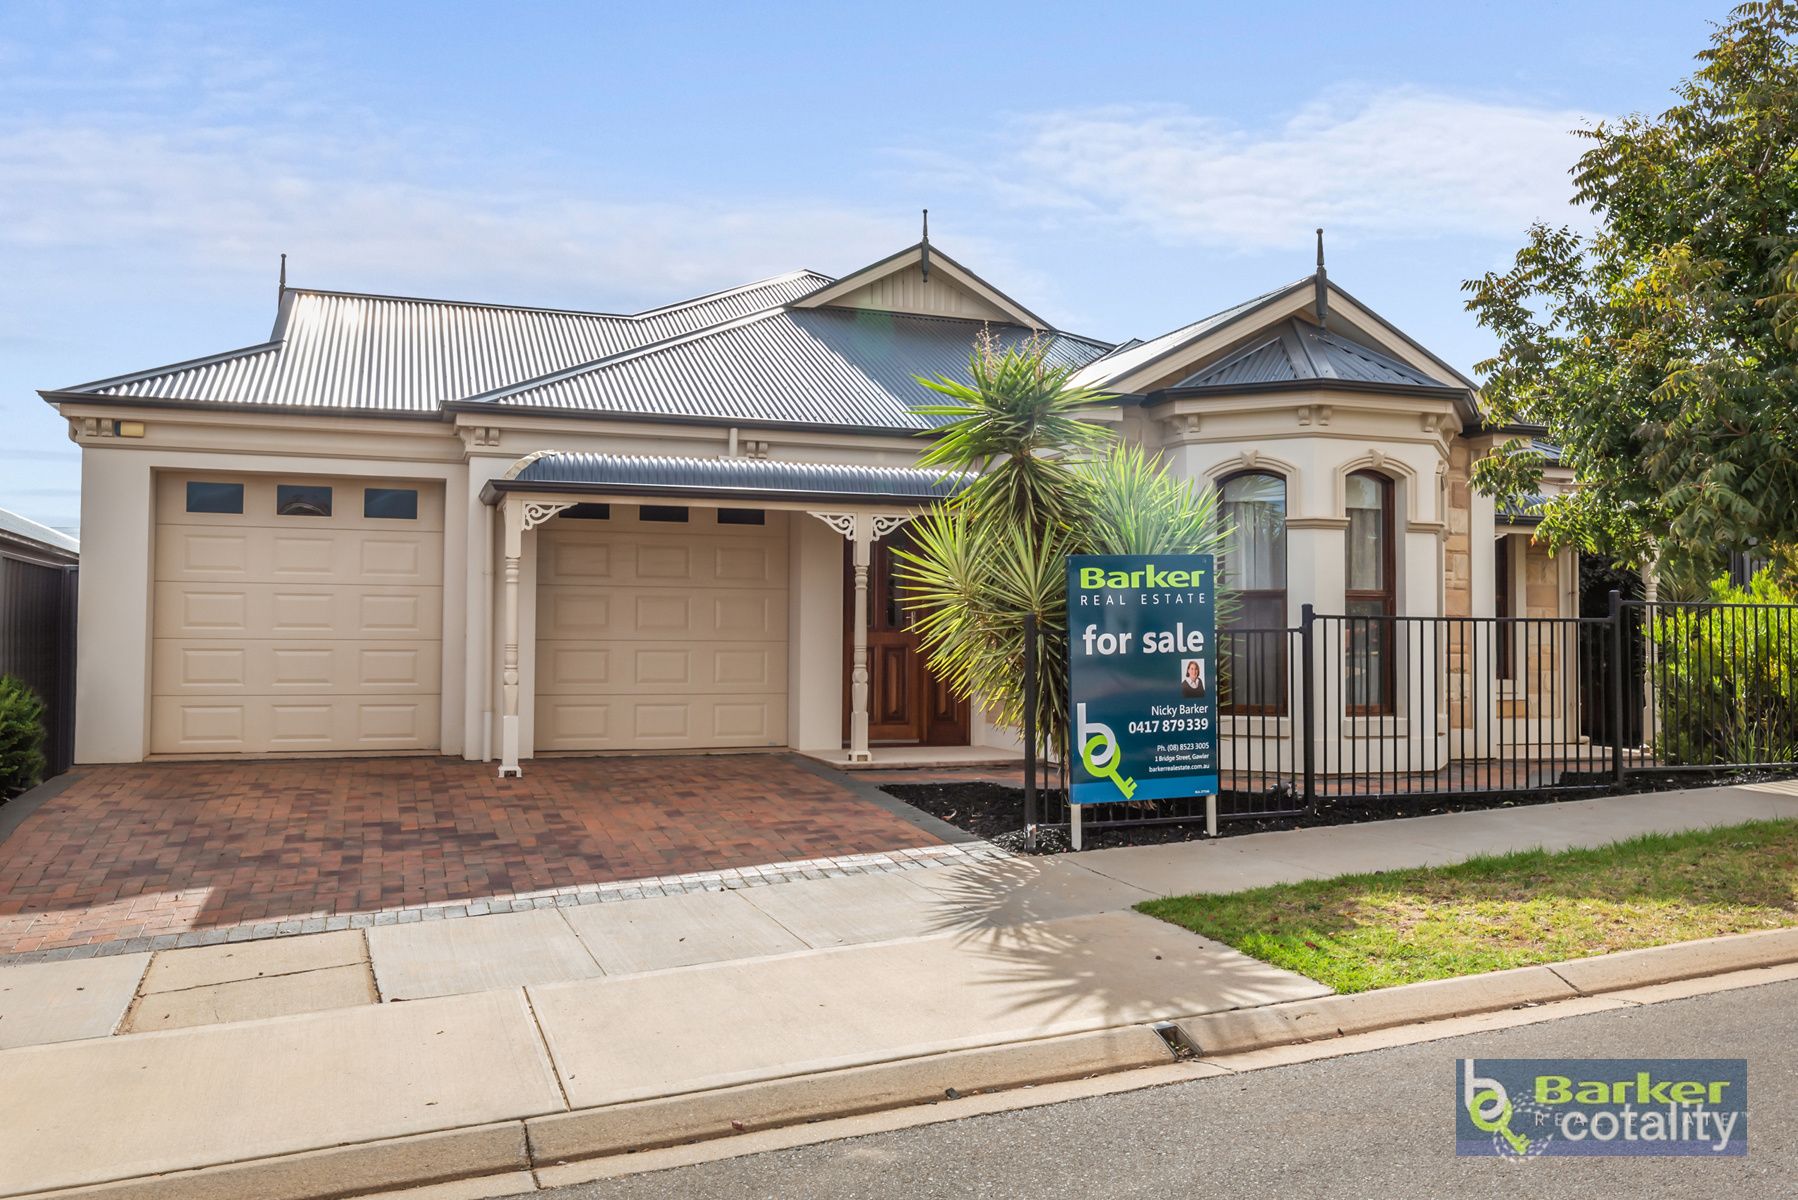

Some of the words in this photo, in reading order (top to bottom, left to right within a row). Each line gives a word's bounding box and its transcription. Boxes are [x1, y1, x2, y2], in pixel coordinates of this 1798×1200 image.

[1080, 564, 1205, 589] Barker
[1080, 594, 1126, 606] REAL
[1141, 593, 1205, 605] ESTATE
[1083, 624, 1132, 656] for
[1143, 622, 1204, 654] sale
[1151, 705, 1177, 717] Nicky
[1179, 704, 1209, 715] Barker
[1128, 720, 1160, 734] 0417
[1162, 719, 1185, 732] 879
[1187, 718, 1209, 731] 339
[1157, 744, 1166, 752] Ph.
[1167, 744, 1179, 752] (08)
[1179, 743, 1195, 751] 8523
[1195, 742, 1210, 750] 3005
[1148, 764, 1210, 773] barkerrealestate.com.au
